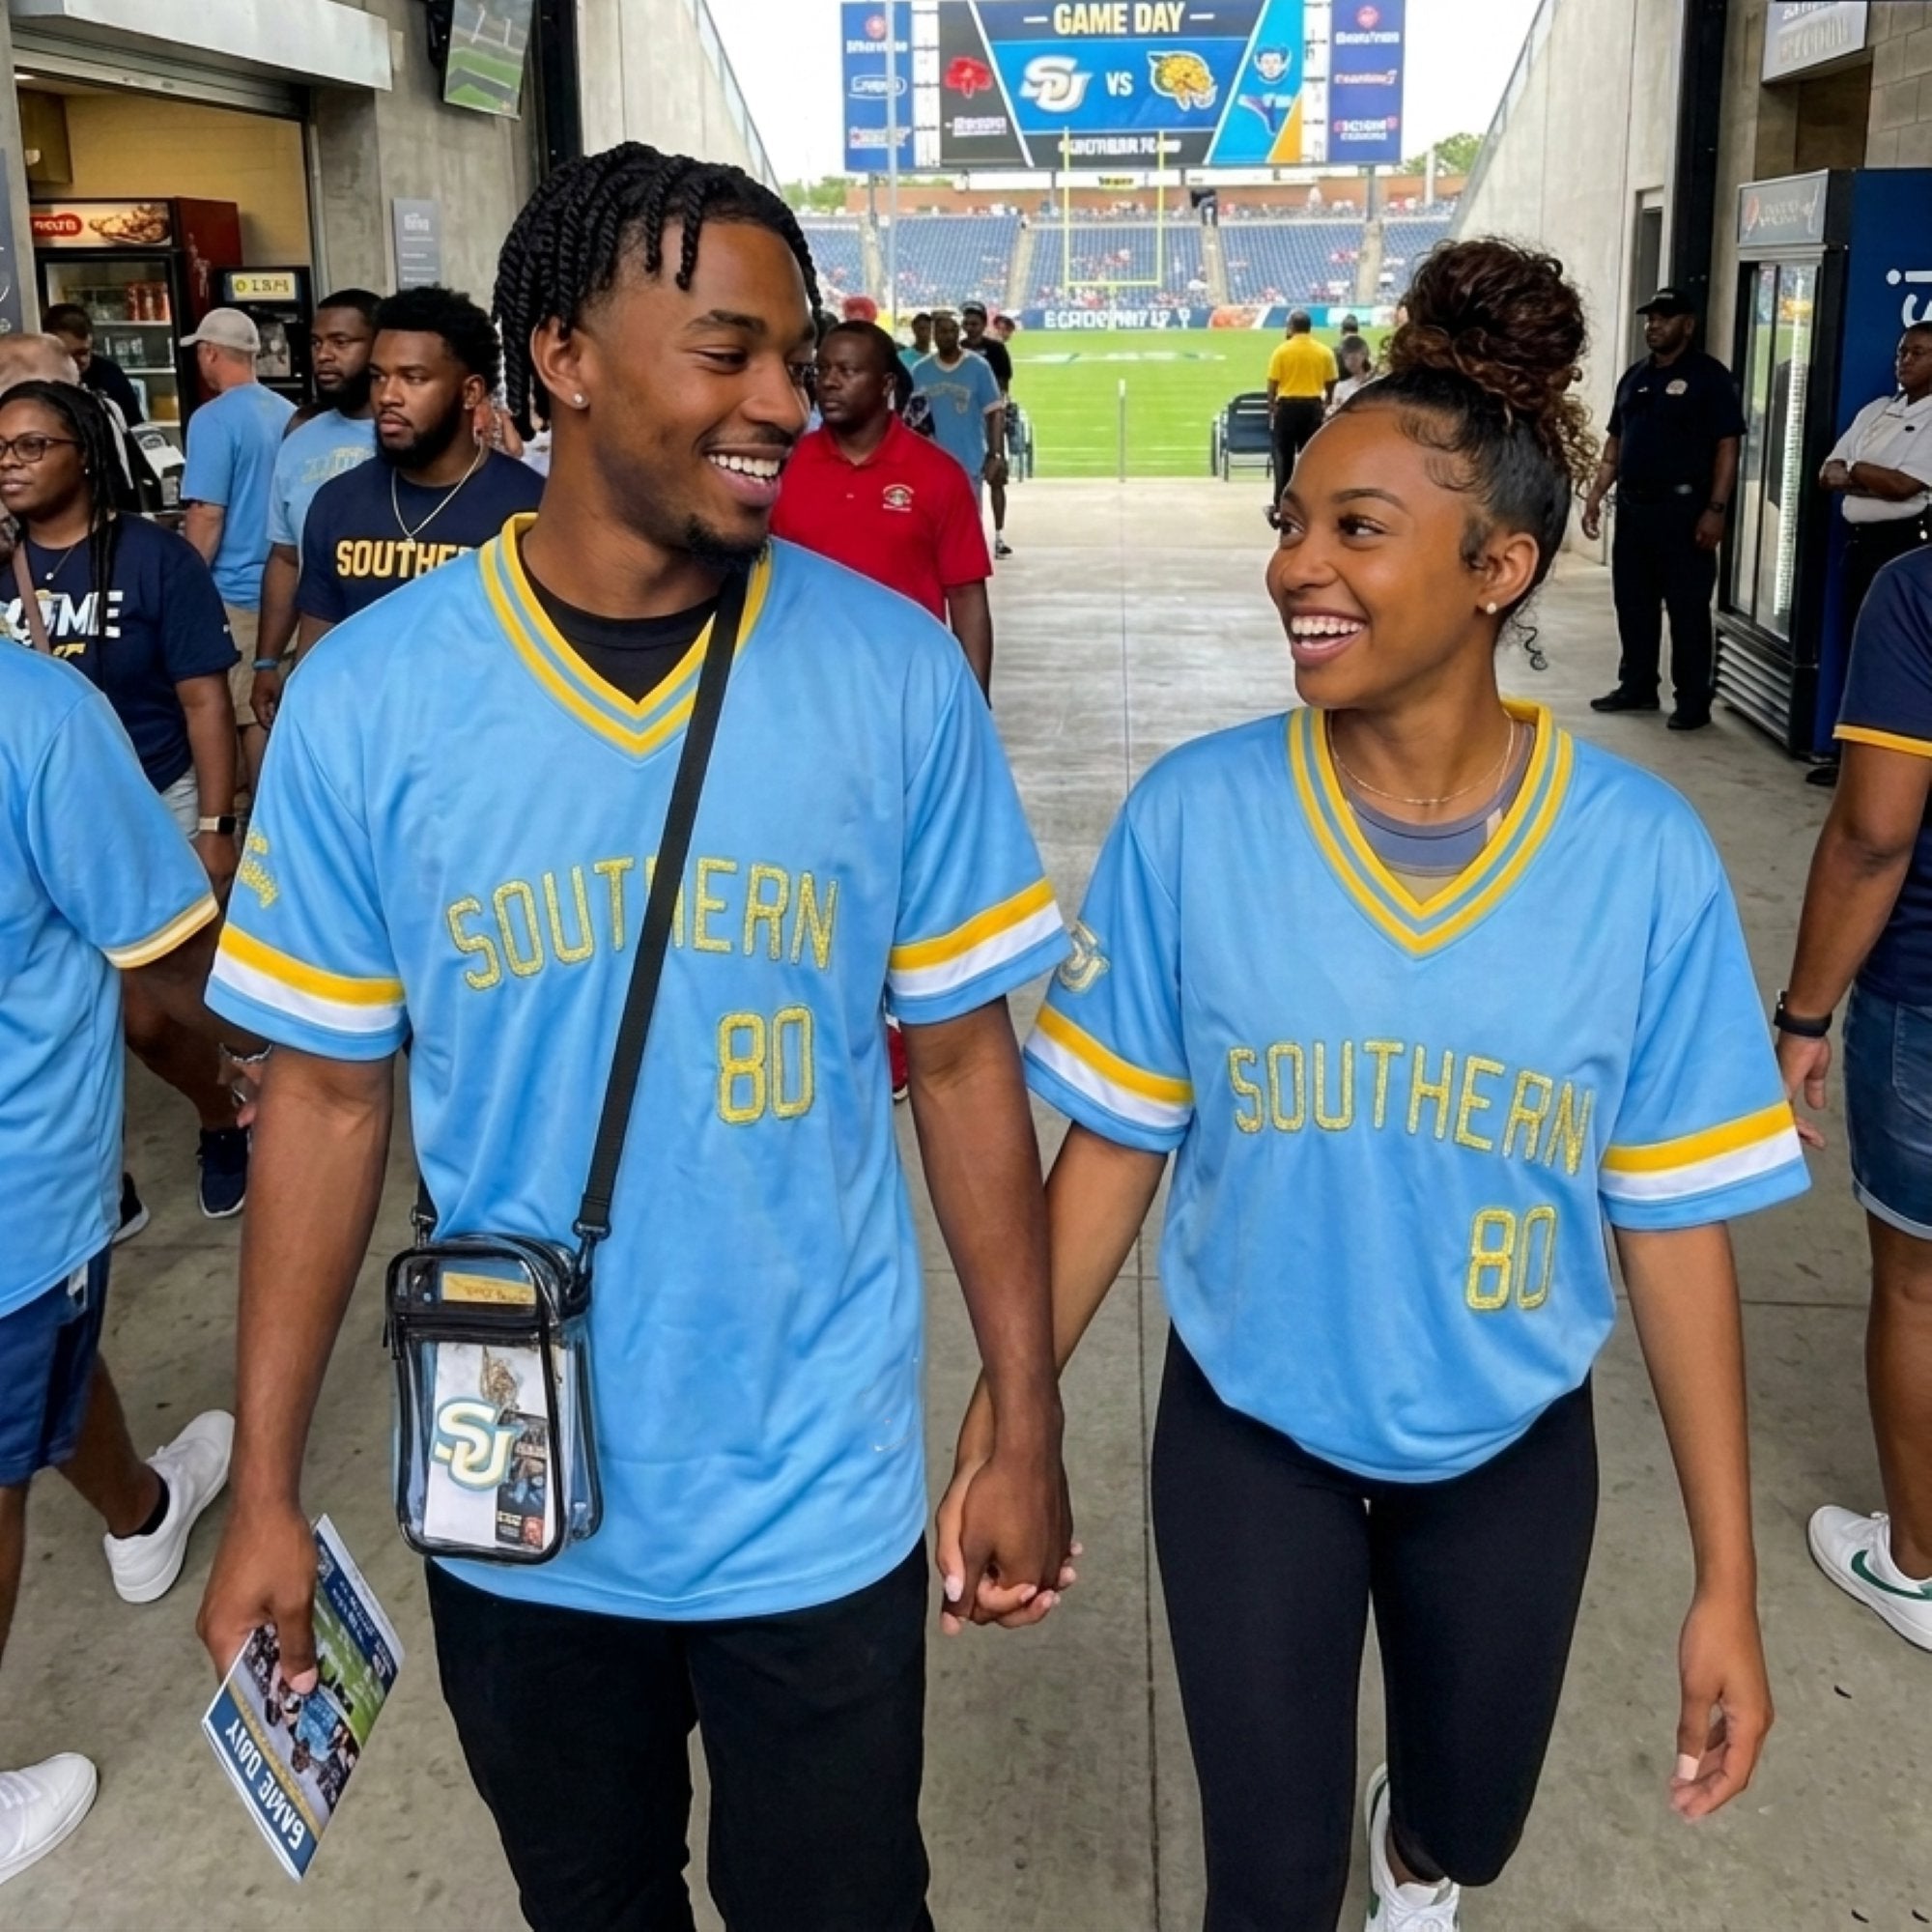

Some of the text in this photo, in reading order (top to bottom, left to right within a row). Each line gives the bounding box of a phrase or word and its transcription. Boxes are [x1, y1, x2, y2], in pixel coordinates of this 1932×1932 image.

[1054, 2, 1185, 35] GAME DAY
[1105, 71, 1133, 97] VS
[336, 539, 475, 580] SOUTHE
[717, 1004, 814, 1126] 80
[1227, 1037, 1595, 1178] SOUTHERN
[1464, 1203, 1557, 1313] 80
